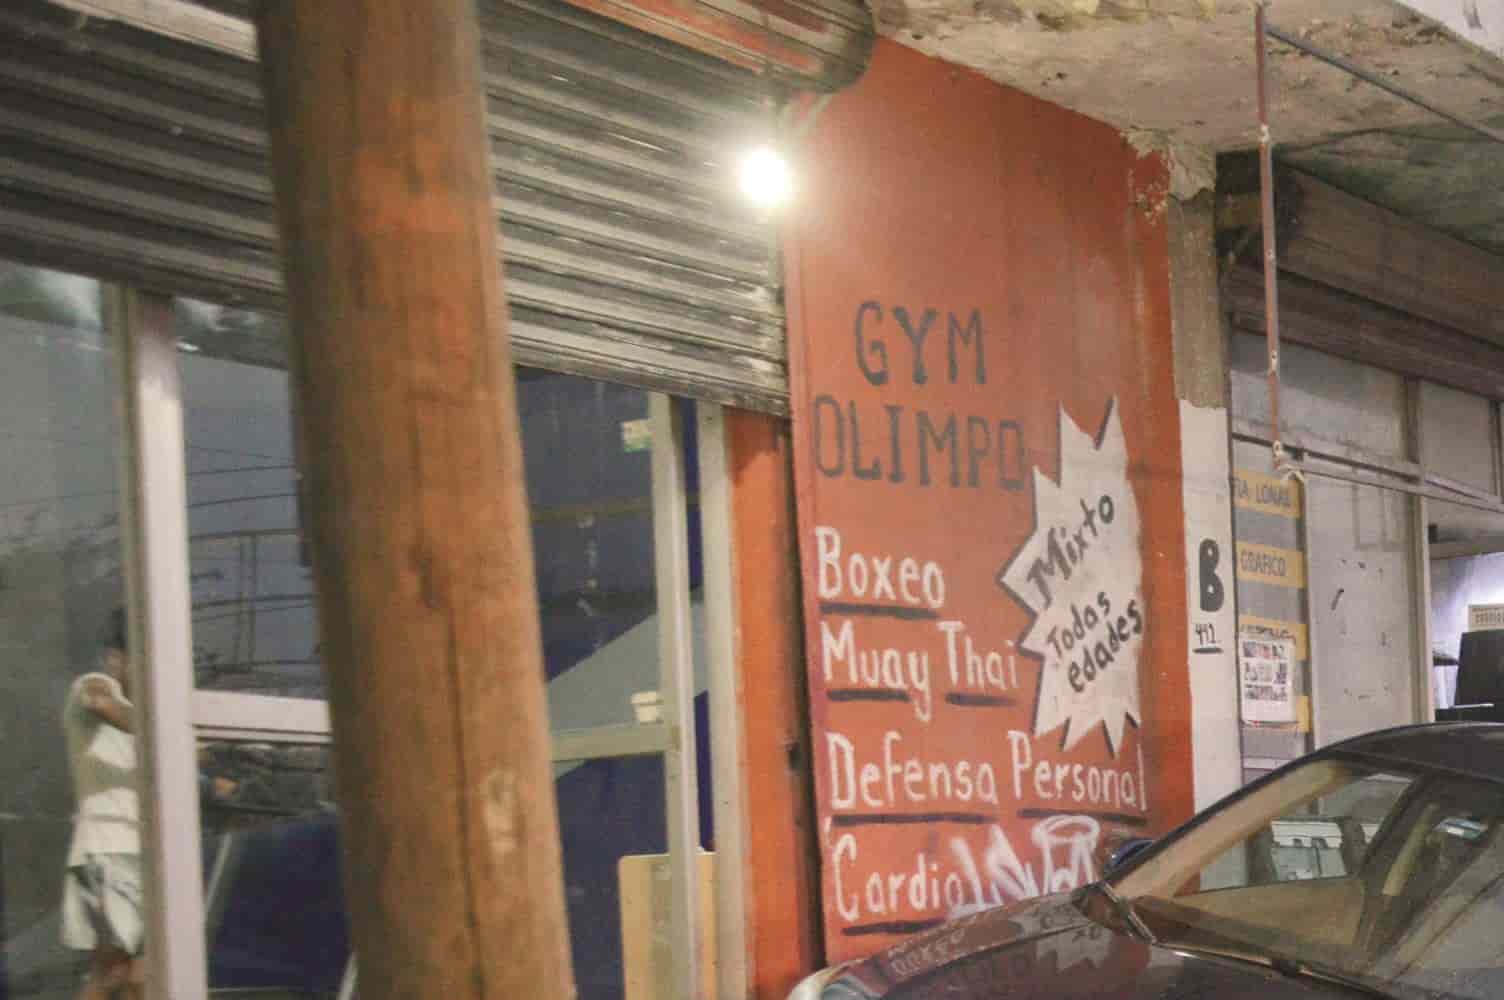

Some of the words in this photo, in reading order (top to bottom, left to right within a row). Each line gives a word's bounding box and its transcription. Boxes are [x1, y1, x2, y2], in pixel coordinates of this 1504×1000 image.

[853, 300, 988, 386] GYM
[812, 394, 1027, 492] OLIMPO
[814, 526, 945, 610] Boxeo
[1026, 494, 1115, 610] Mixto
[1198, 538, 1225, 613] B
[1046, 591, 1111, 660] Todos
[1067, 599, 1143, 693] edades
[820, 621, 931, 722] Muay
[937, 621, 1020, 690] Thai
[825, 732, 999, 810] Defensa
[1007, 730, 1147, 812] Personal
[832, 832, 968, 921] Cardio
